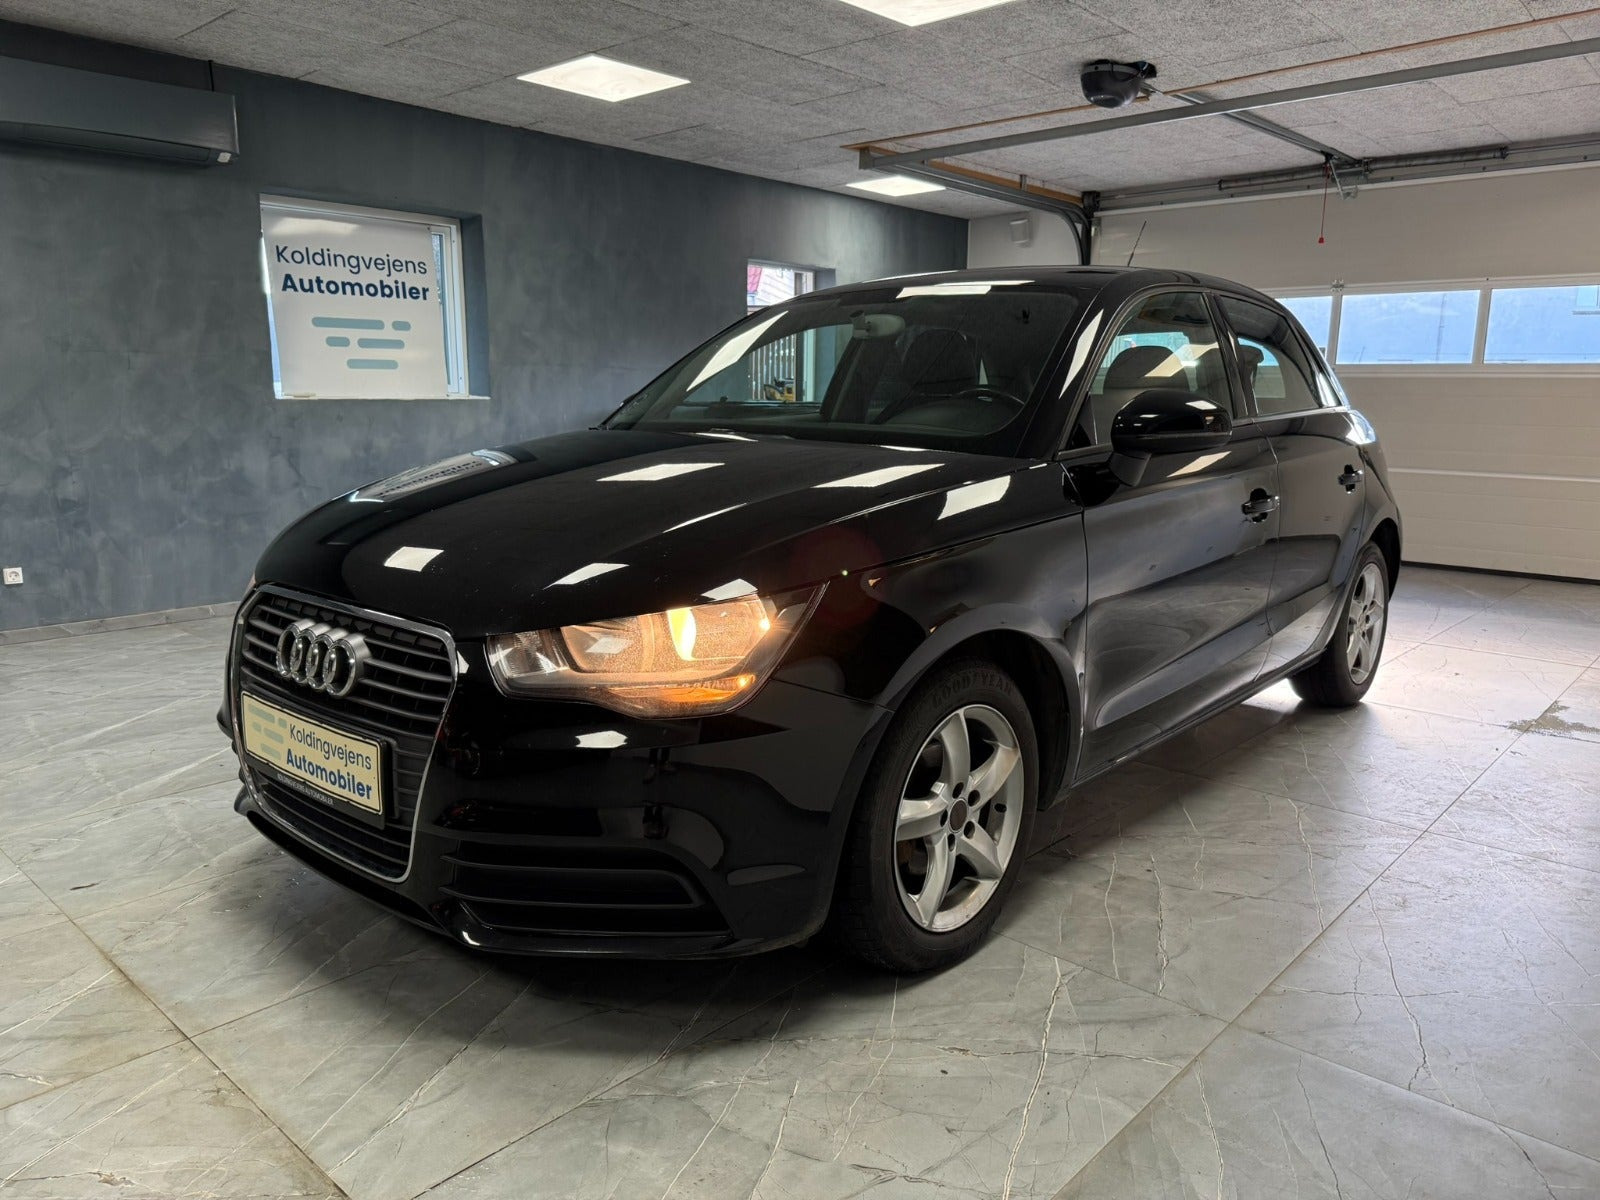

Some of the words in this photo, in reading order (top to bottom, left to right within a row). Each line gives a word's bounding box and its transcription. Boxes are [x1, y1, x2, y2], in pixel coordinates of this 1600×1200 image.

[275, 244, 428, 277] Koldingvejens
[281, 273, 430, 300] Automobiler
[289, 724, 372, 770] Koldingvejens
[286, 748, 372, 800] Automobiler
